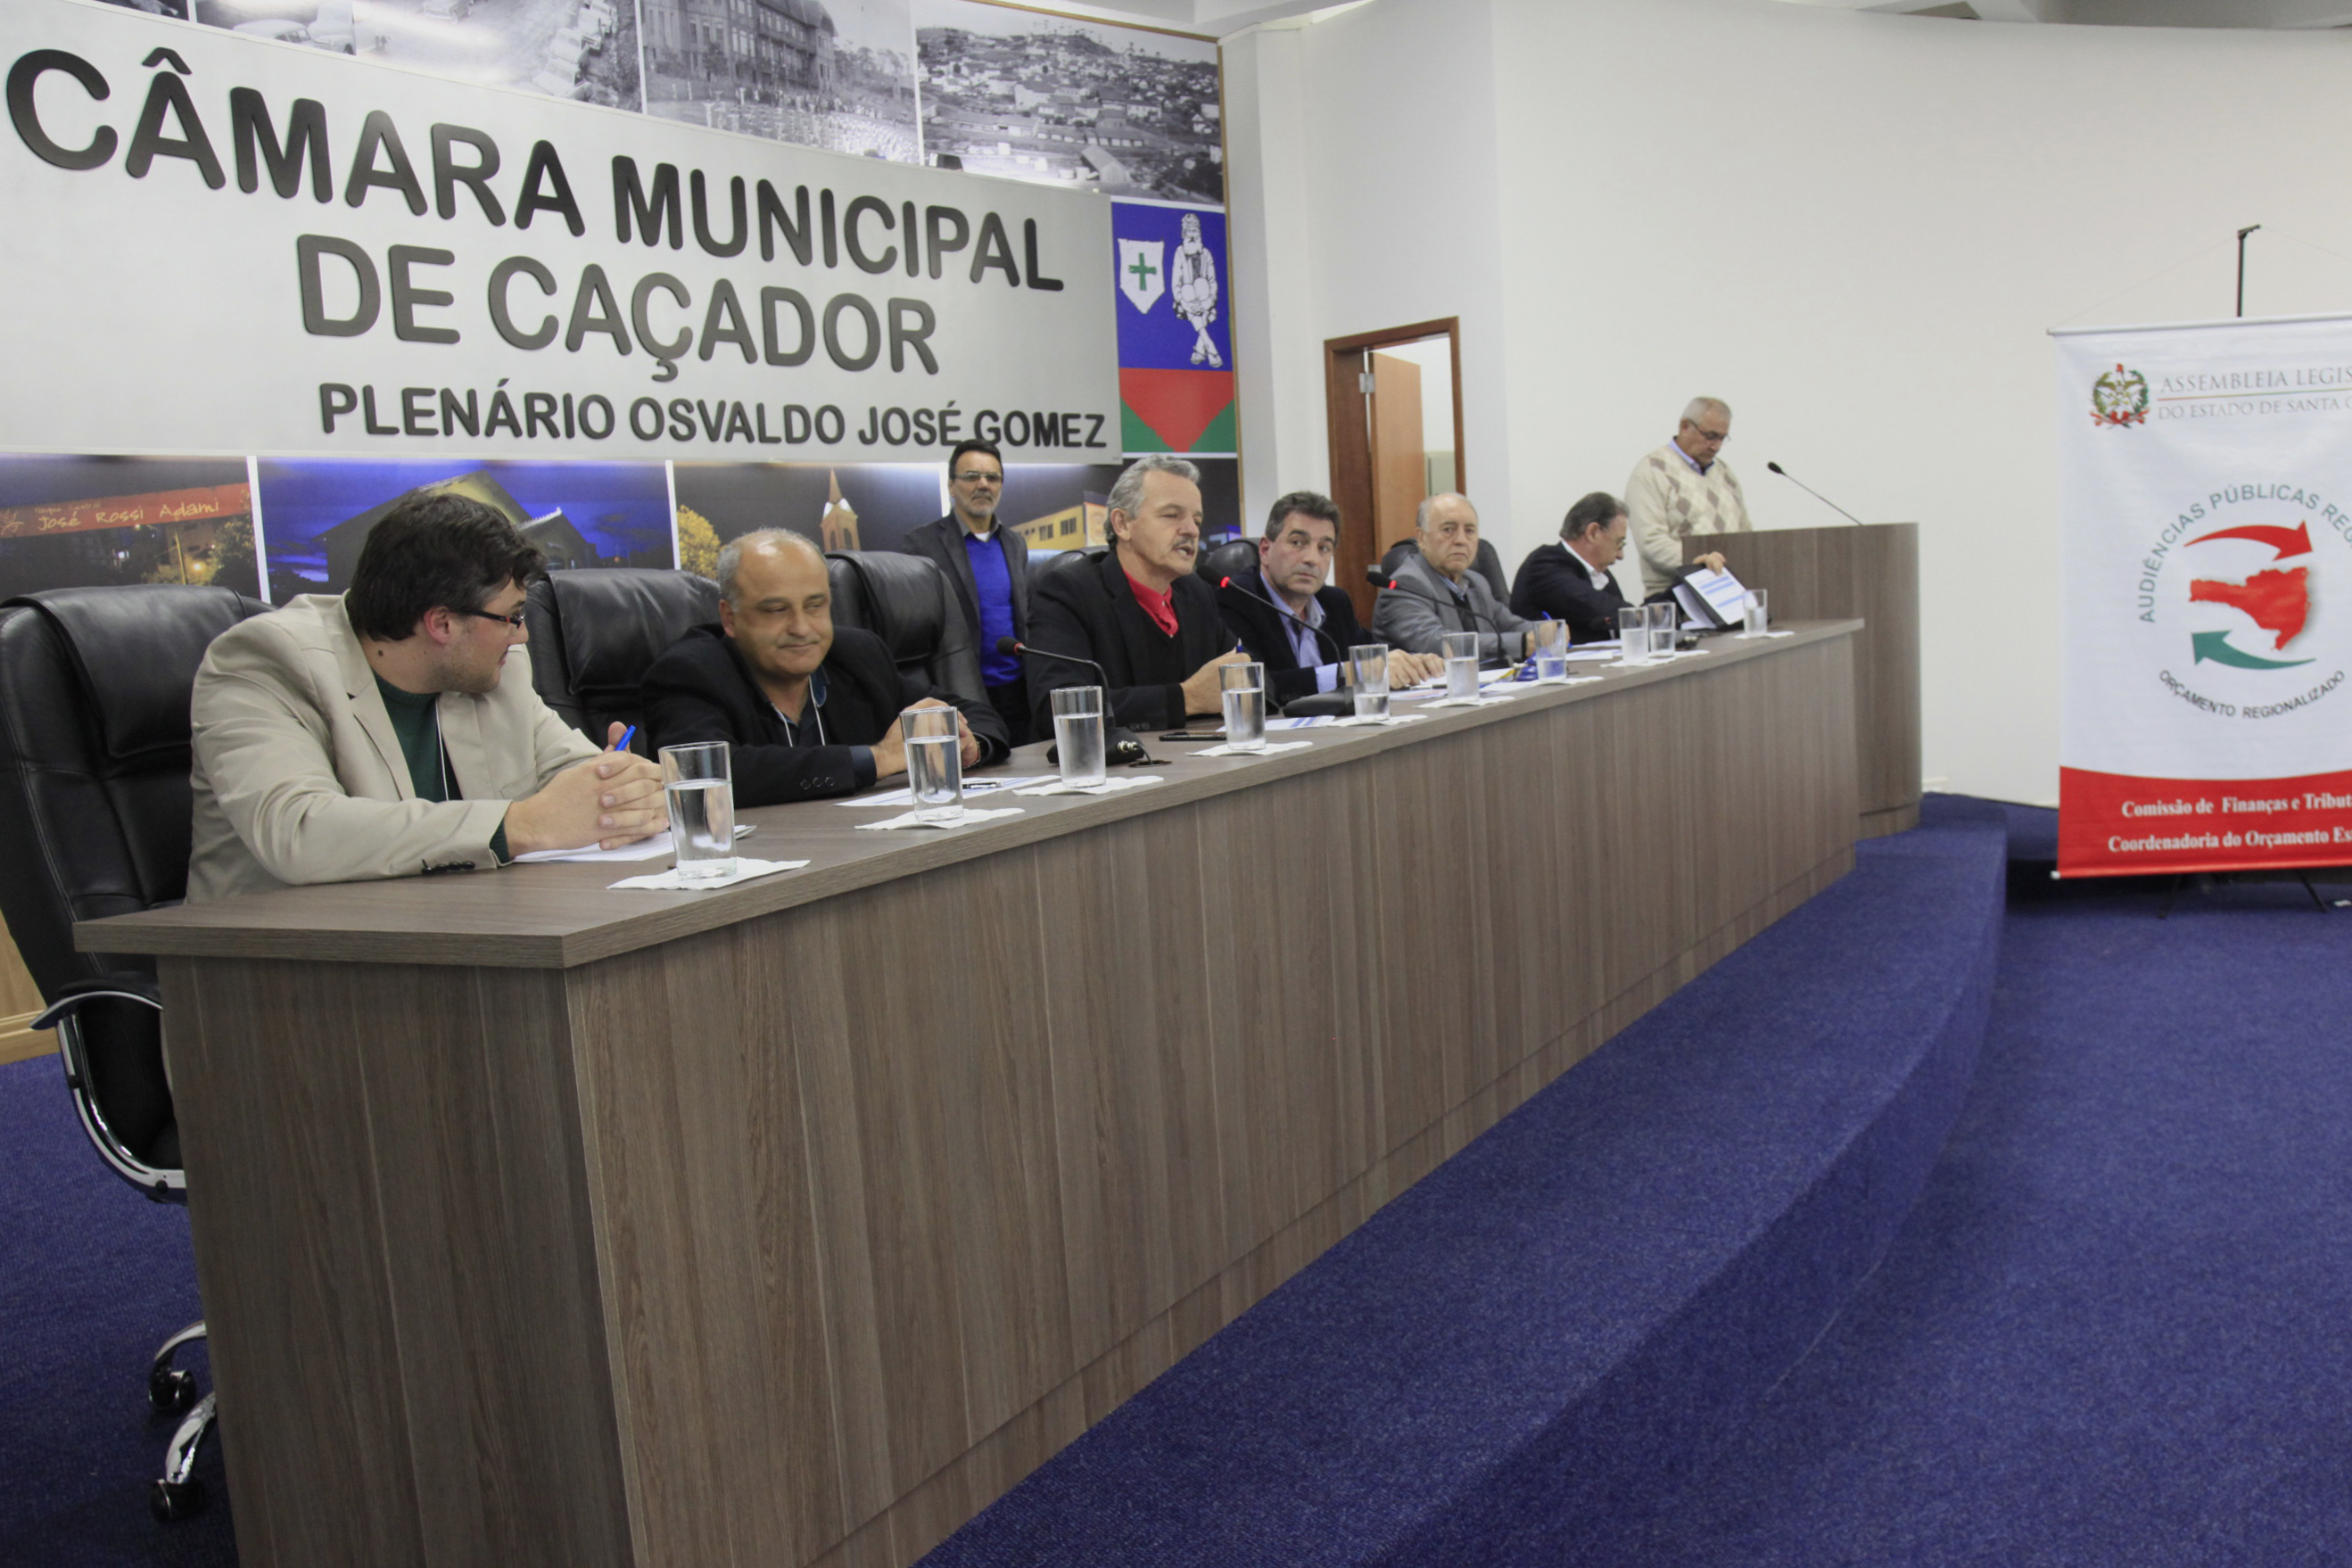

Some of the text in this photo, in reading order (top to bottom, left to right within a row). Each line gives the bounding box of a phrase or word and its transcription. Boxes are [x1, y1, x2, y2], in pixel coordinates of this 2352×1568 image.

[6, 47, 1064, 292] CÂMARA MUNICIPAL
[297, 234, 939, 382] DE CAÇADOR
[2160, 371, 2289, 393] ASSEMBLEIA
[319, 378, 1107, 448] PLENÁRIO OSVALDO JOSÉ GOMEZ
[2158, 405, 2184, 420] DO
[2190, 401, 2254, 418] ESTADO
[2259, 400, 2280, 415] DE
[2288, 397, 2340, 413] SANTA
[37, 498, 219, 532] José Rossi Adami
[2138, 503, 2206, 623] AUDIÊNCIAS
[2209, 483, 2320, 510] PÚBLICAS
[2159, 670, 2345, 718] ORÇAMENTO REGIONALIZADO
[2121, 799, 2192, 818] Comissão
[2195, 797, 2215, 813] de
[2222, 796, 2289, 815] Finanças
[2290, 797, 2300, 811] e
[2108, 830, 2219, 853] Coordenadoria
[2223, 830, 2242, 847] do
[2245, 829, 2330, 849] Orçamento
